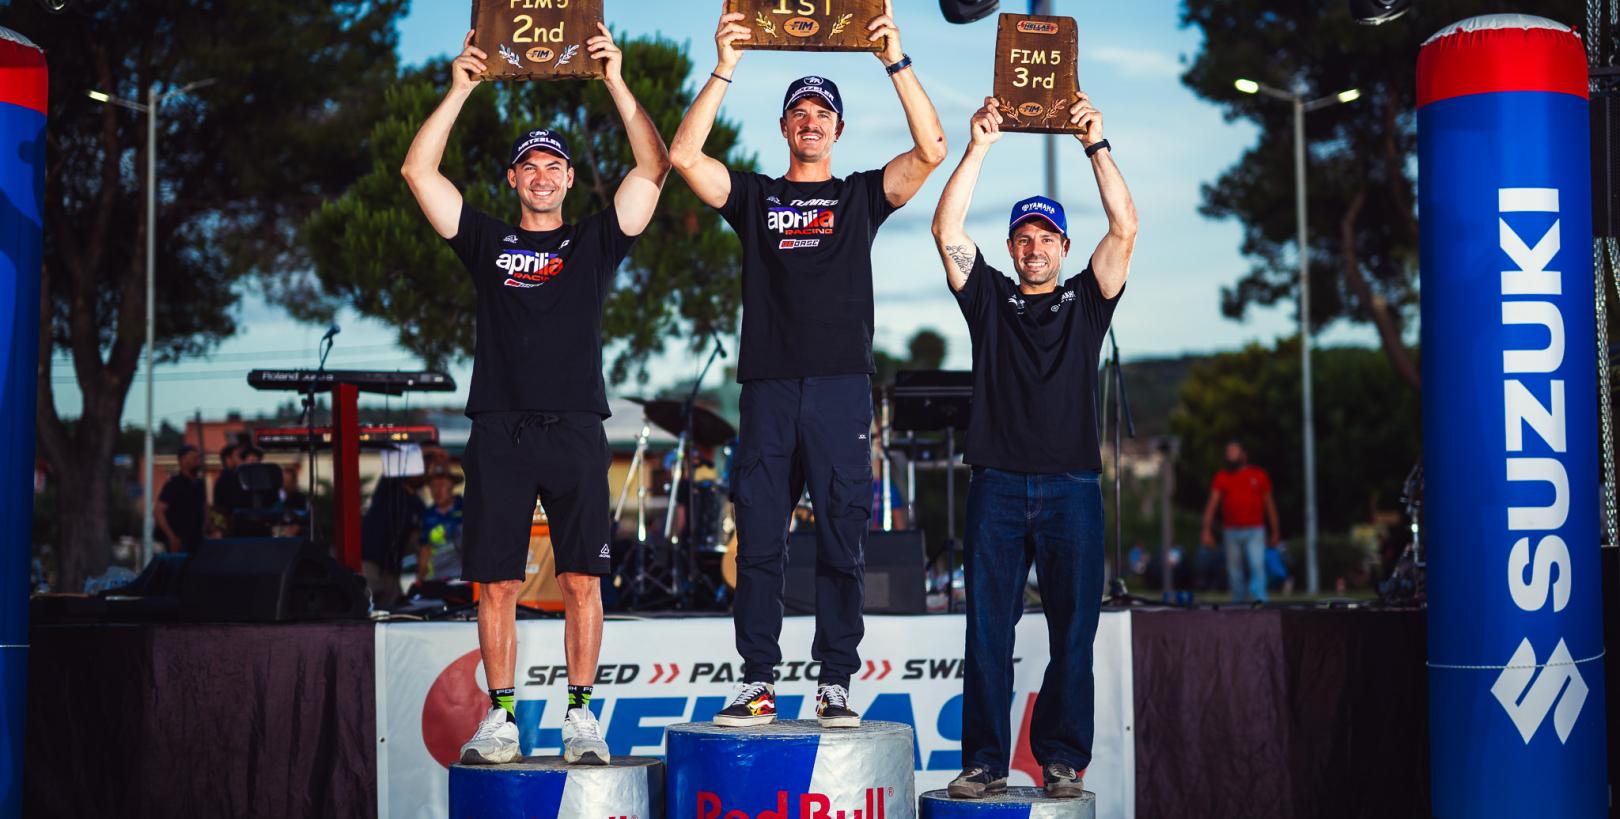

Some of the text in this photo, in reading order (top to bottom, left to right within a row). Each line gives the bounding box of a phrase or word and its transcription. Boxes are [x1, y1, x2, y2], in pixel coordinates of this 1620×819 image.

[512, 14, 565, 43] 2nd
[792, 21, 814, 31] FIM
[530, 50, 550, 58] FIM
[1010, 49, 1061, 65] FIM 5
[1012, 67, 1056, 89] 3rd
[1024, 105, 1041, 113] FIM
[1029, 202, 1056, 215] YAMAHA
[767, 208, 835, 234] aprilia
[784, 228, 834, 236] RACING
[495, 251, 564, 275] aprilia
[262, 372, 300, 381] Roland
[1498, 187, 1572, 613] SUZUKI
[524, 663, 641, 686] SPED
[689, 660, 823, 684] PAIO
